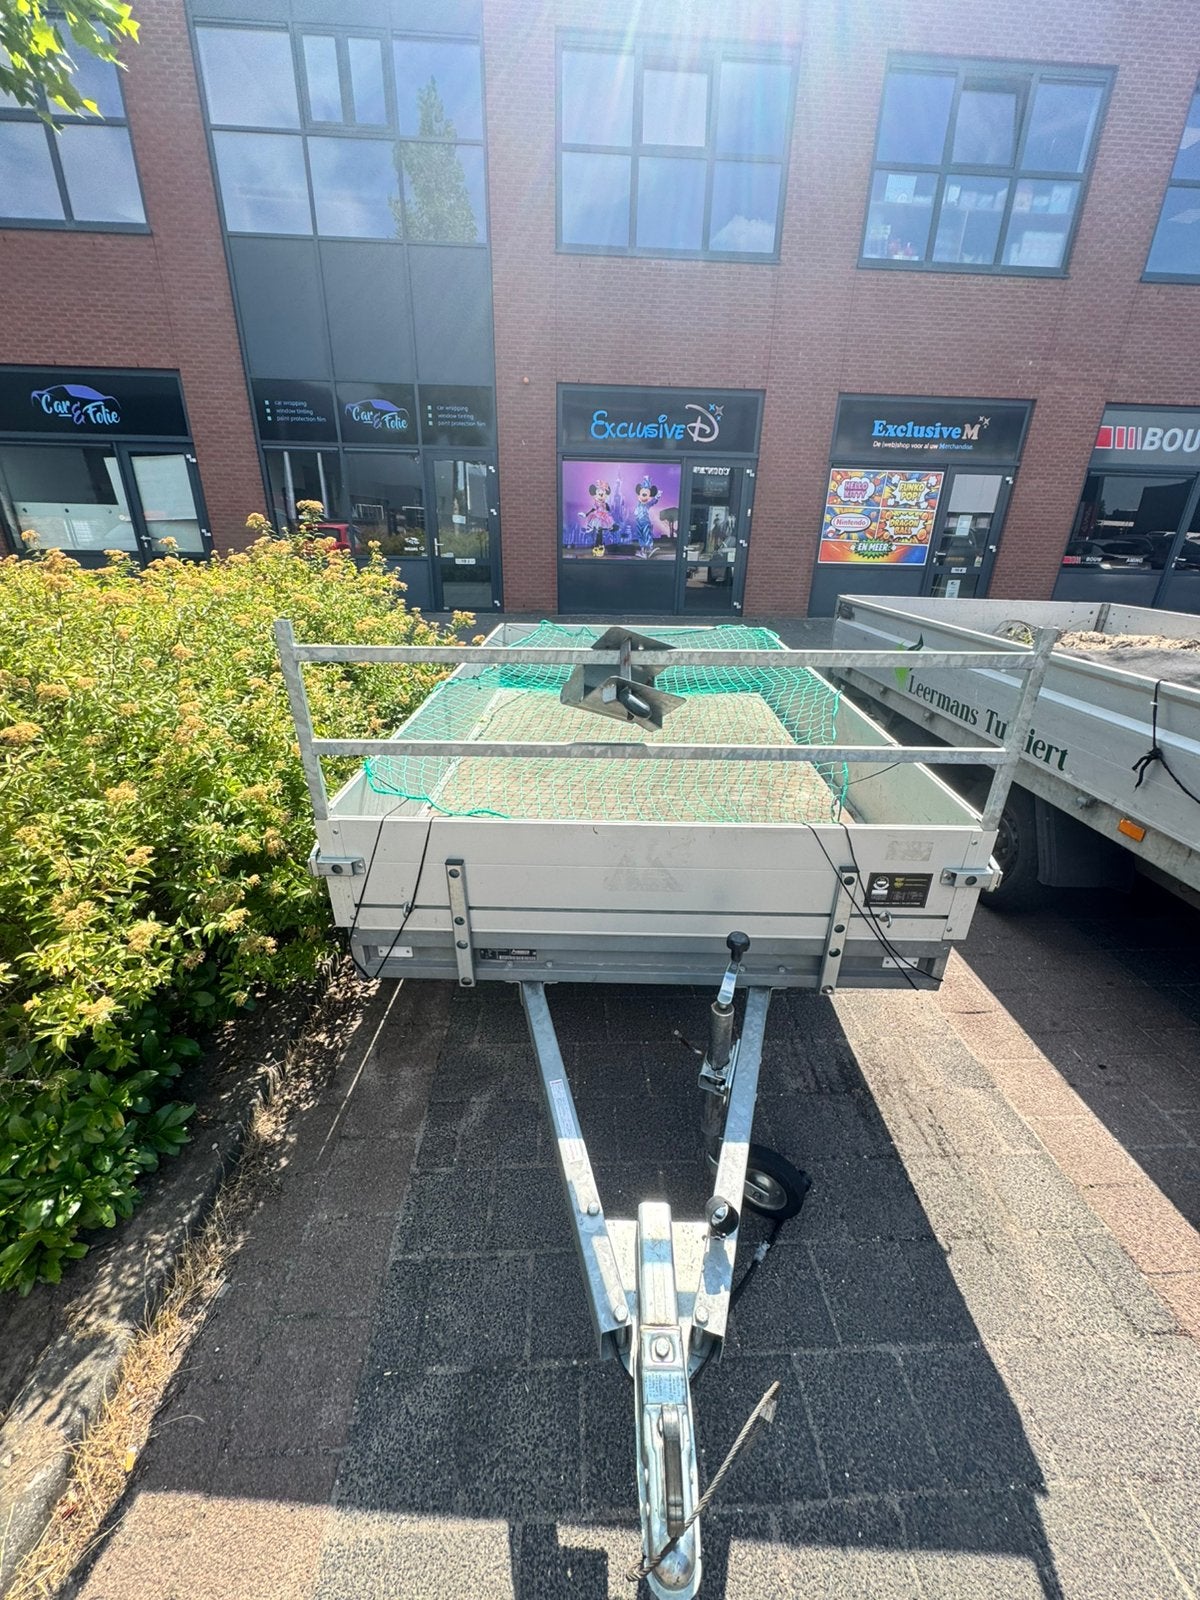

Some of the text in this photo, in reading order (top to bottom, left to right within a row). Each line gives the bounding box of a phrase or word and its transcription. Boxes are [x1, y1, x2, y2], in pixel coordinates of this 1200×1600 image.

[41, 394, 72, 415] Car
[83, 401, 121, 425] Folie
[352, 406, 374, 422] Car
[381, 411, 409, 430] Folie
[1142, 427, 1200, 452] BOU
[844, 480, 868, 490] HELLO
[898, 482, 926, 492] FUNKO
[835, 518, 867, 527] Nintendo
[888, 518, 920, 527] DRAGON
[857, 542, 869, 552] EN
[908, 675, 1069, 772] Leermans Tuiert
